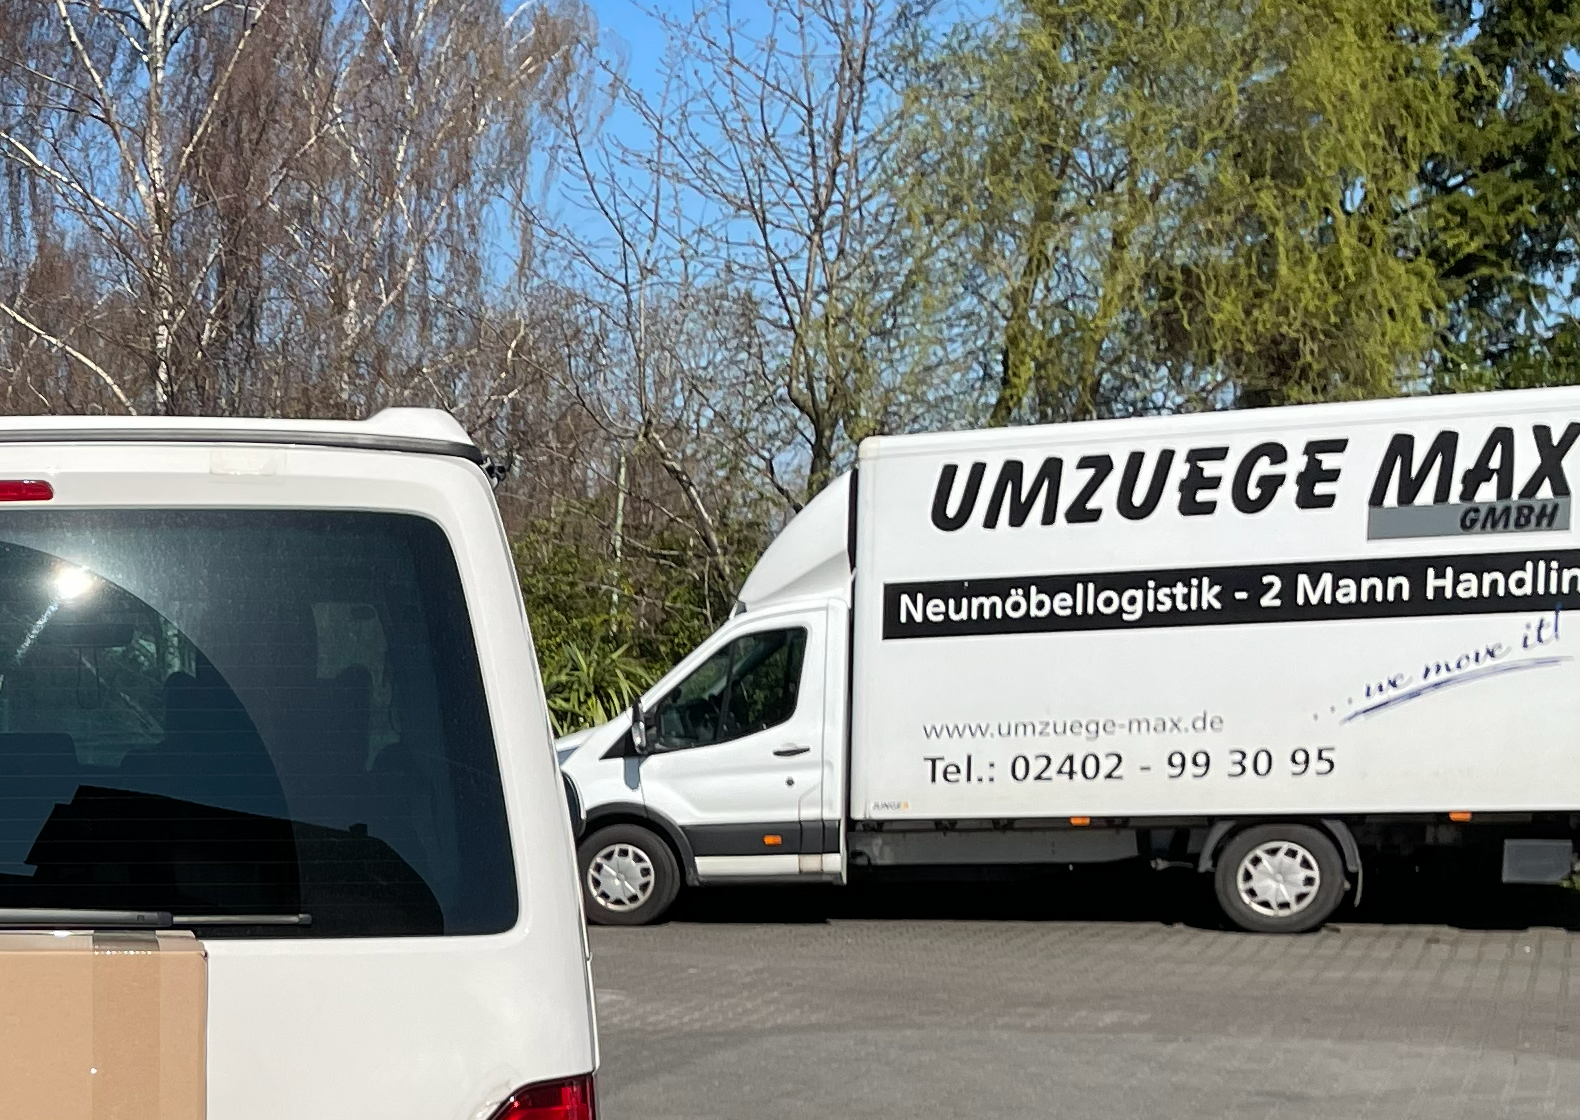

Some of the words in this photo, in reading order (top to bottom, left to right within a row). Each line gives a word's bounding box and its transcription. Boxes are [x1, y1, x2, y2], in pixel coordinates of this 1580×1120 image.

[930, 438, 1348, 532] UMZUEGE
[1369, 421, 1580, 508] MAX
[1459, 502, 1559, 532] GMBH
[898, 576, 1223, 625] Neumöbellogistik
[1260, 577, 1282, 609] 2
[1295, 572, 1411, 606] Mann
[1425, 560, 1580, 600] Handlin
[1423, 642, 1511, 680] move
[923, 710, 1224, 742] www.umzuege-max.de
[923, 754, 996, 784] Tel.:
[1010, 752, 1124, 782] 02402
[1166, 750, 1210, 779] 99
[1227, 749, 1273, 778] 30
[1290, 747, 1336, 776] 95
